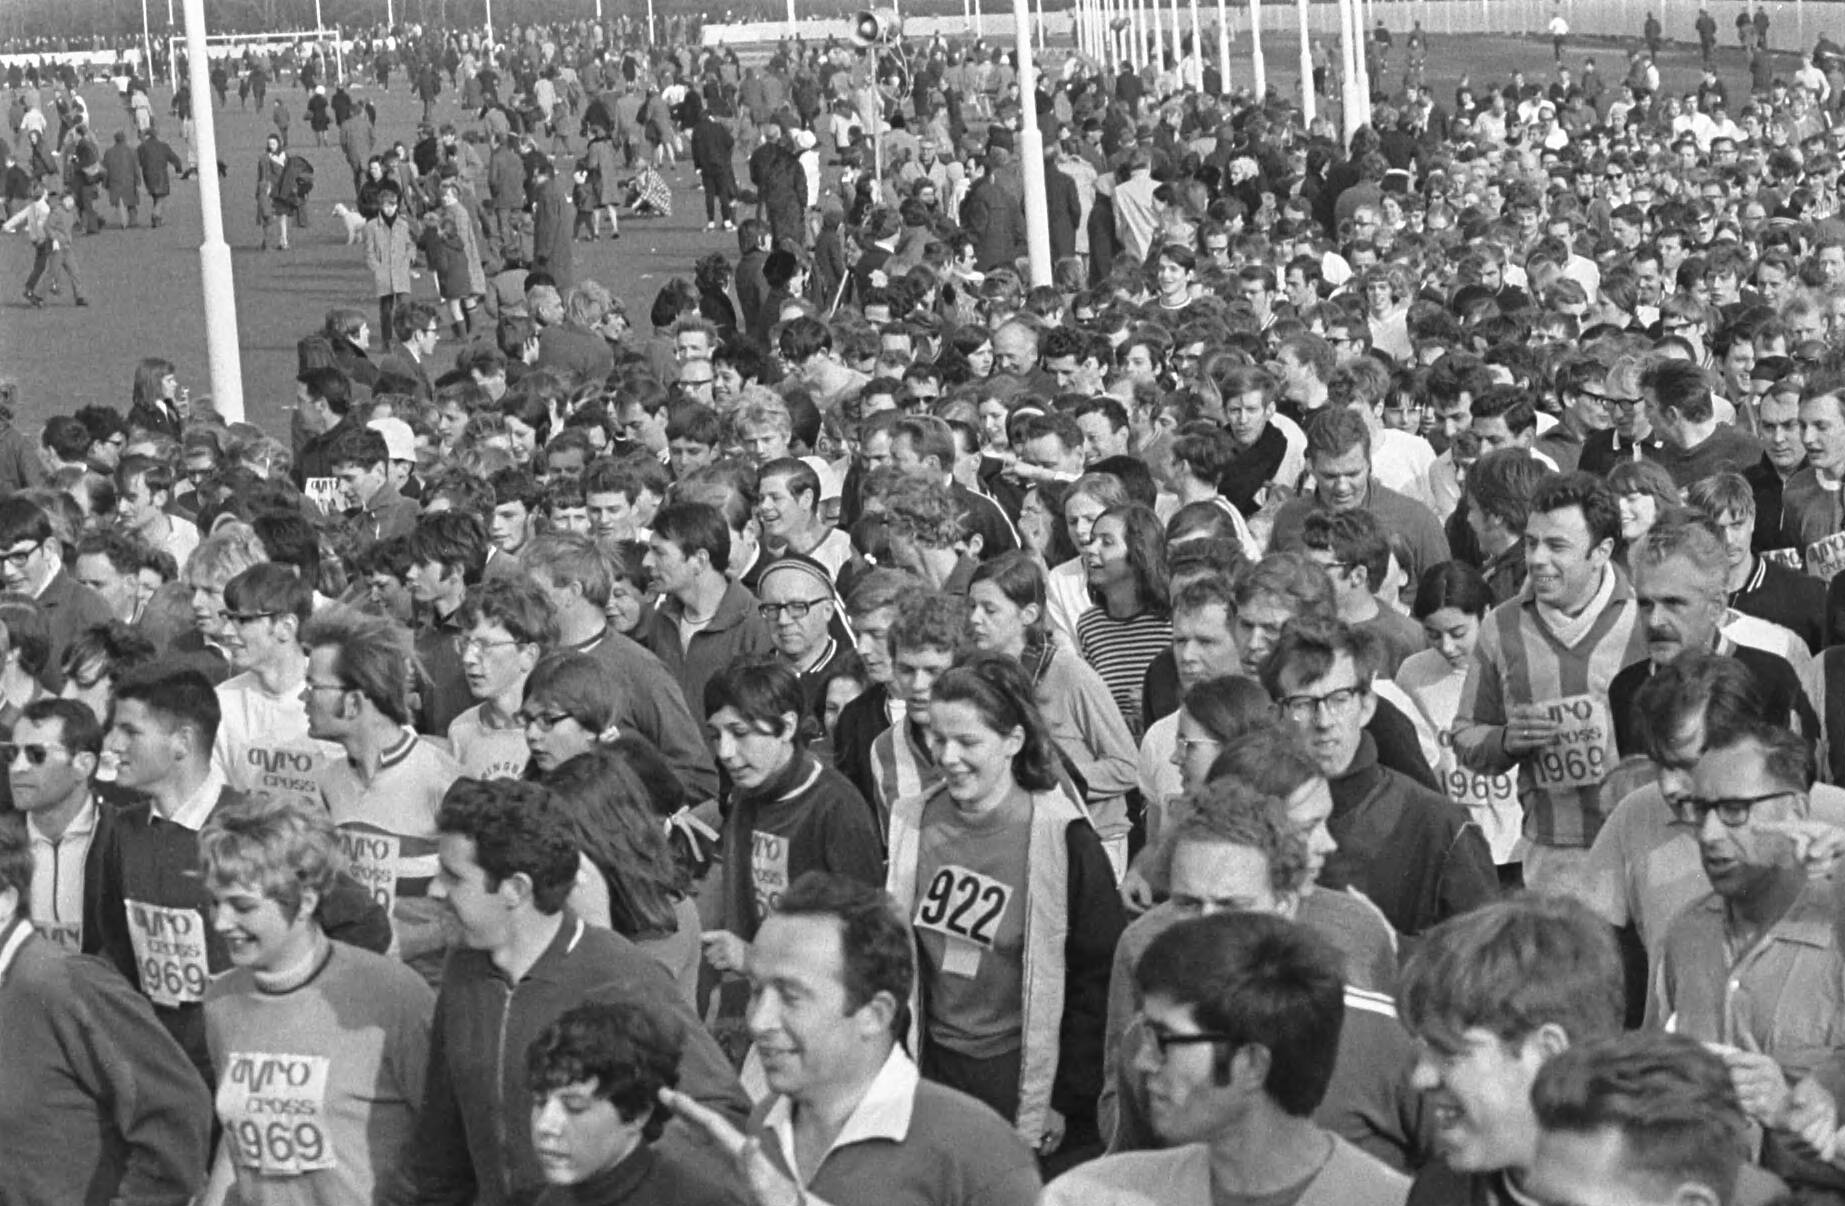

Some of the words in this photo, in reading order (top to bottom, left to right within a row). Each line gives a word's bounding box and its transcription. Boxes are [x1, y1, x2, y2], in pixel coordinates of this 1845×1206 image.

[248, 748, 312, 773] avro
[1536, 746, 1605, 782] 1969
[263, 775, 317, 793] cross
[1441, 770, 1512, 800] 1969
[921, 868, 1006, 945] 922
[140, 956, 206, 997] 969
[232, 1059, 311, 1092] avro
[246, 1098, 316, 1116] cross
